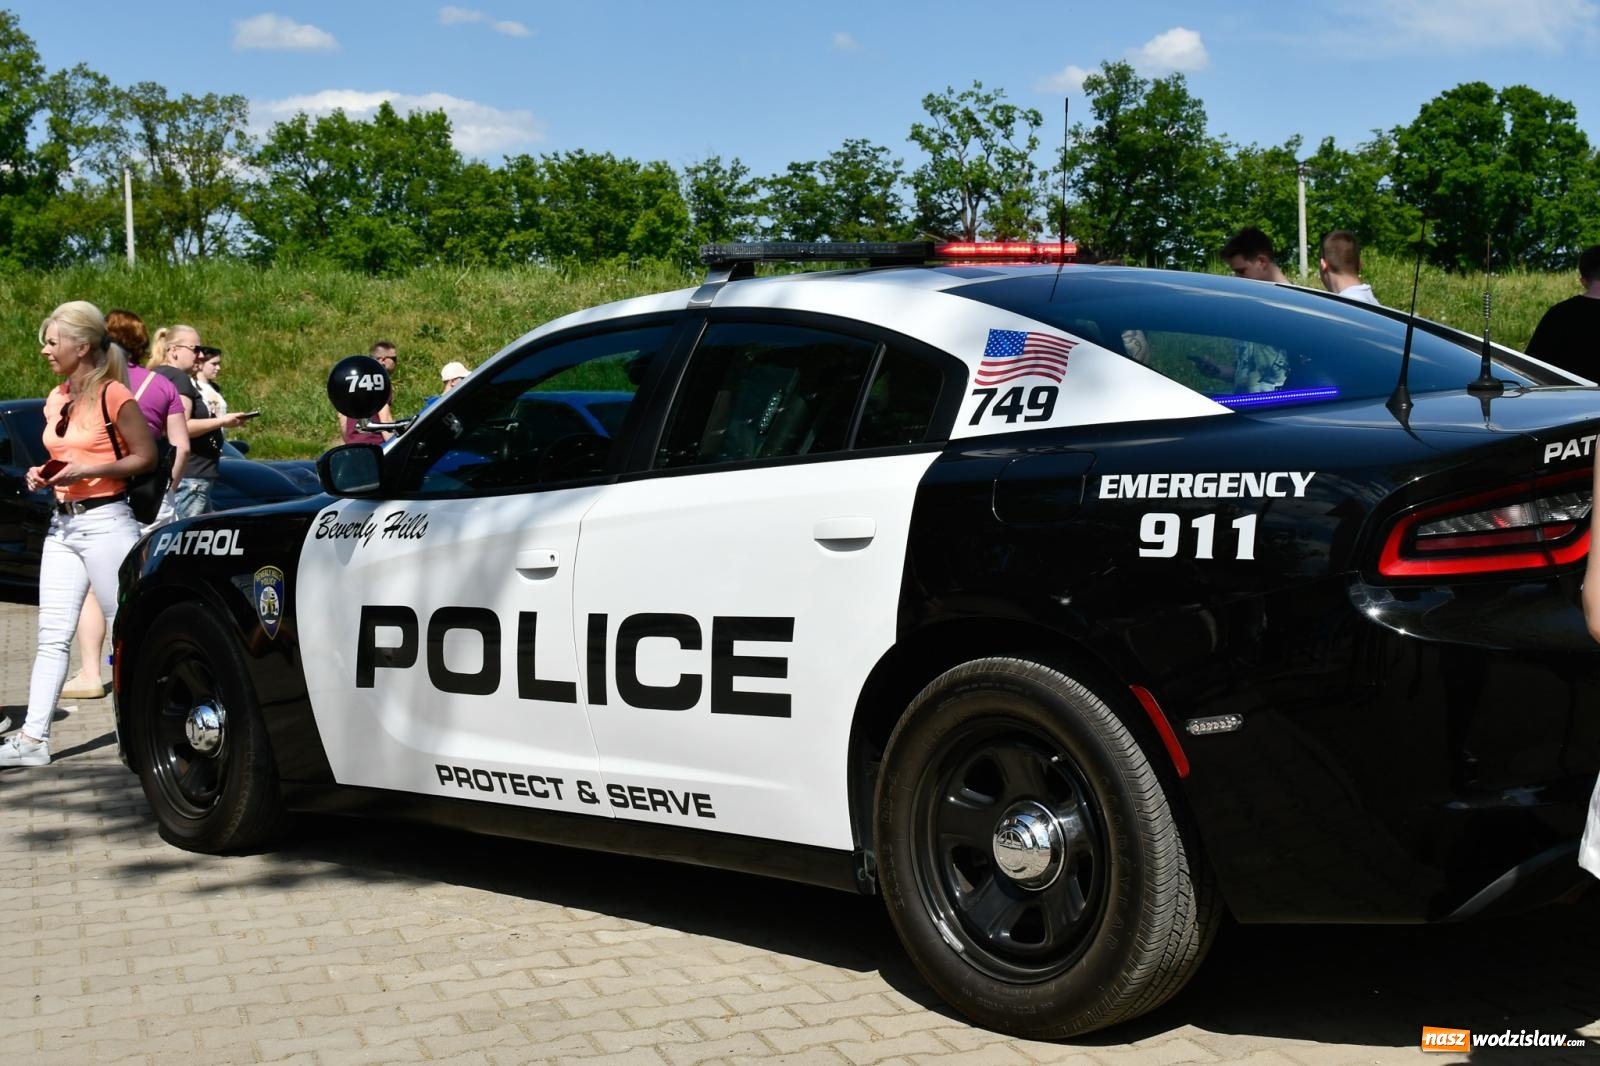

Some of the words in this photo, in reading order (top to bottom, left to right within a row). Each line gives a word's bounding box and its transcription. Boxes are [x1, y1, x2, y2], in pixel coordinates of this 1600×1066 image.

[345, 373, 386, 393] 749
[968, 385, 1060, 426] 749
[1543, 434, 1597, 464] PAT
[1098, 471, 1316, 500] EMERGENCY
[153, 528, 244, 557] PATROL
[315, 510, 377, 548] Beverly
[382, 510, 429, 540] Hills
[1138, 512, 1258, 561] 911
[355, 604, 796, 718] POLICE
[435, 764, 564, 801] PROTECT
[577, 780, 600, 805] &
[606, 783, 717, 819] SERVE
